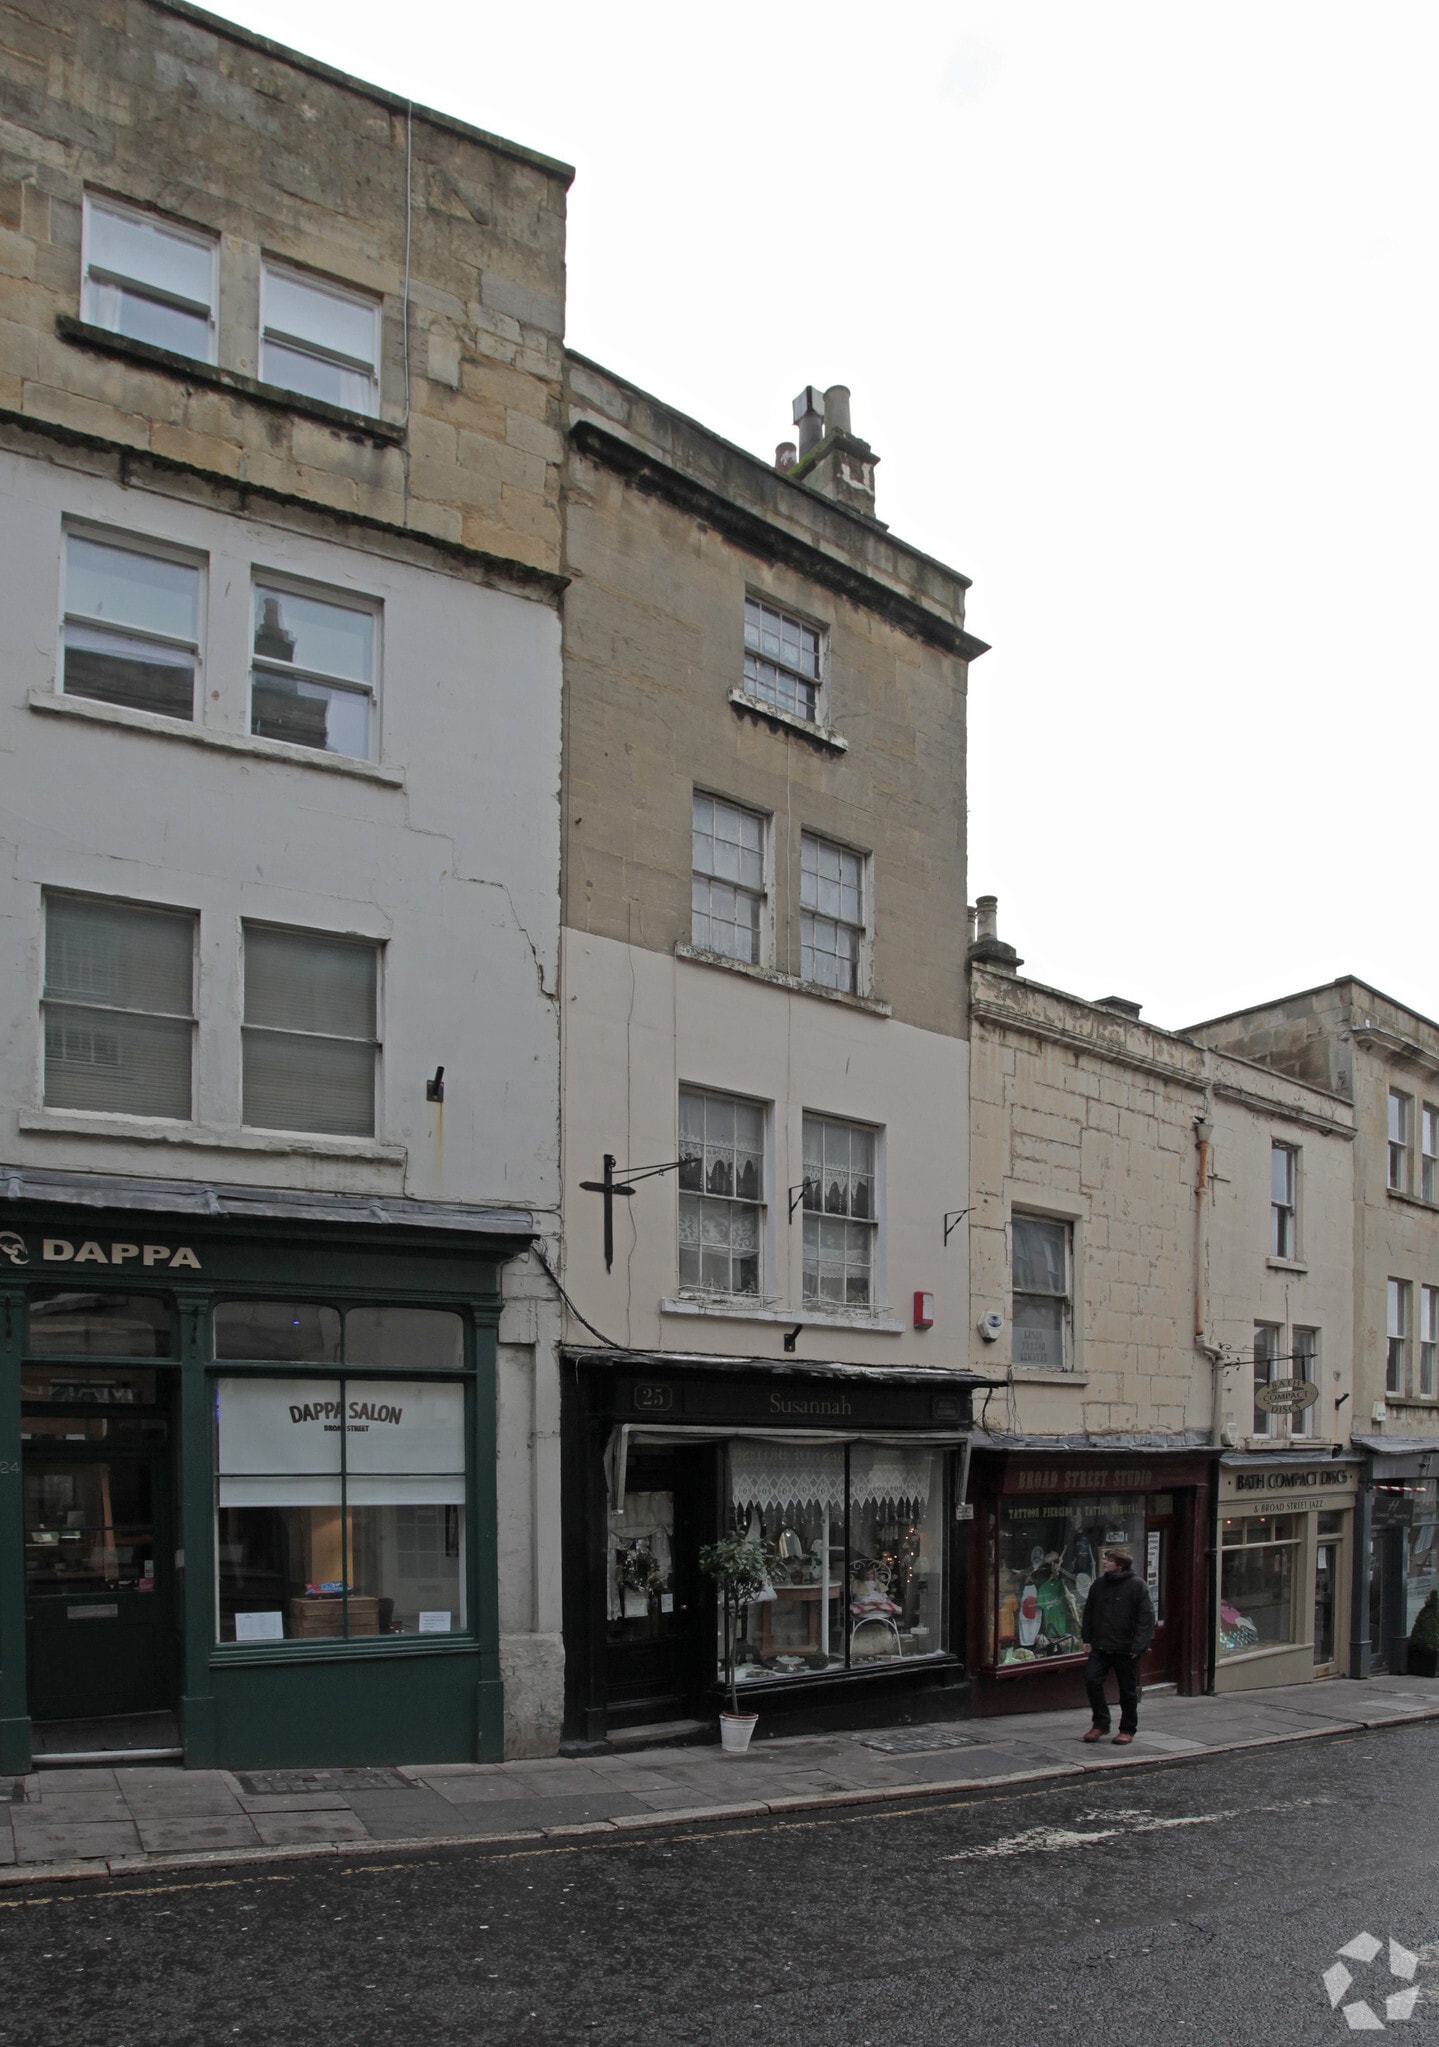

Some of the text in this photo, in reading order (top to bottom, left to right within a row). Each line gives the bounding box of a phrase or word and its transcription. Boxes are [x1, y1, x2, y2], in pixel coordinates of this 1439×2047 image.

[43, 1238, 202, 1269] DAPPA
[1271, 1380, 1302, 1389] BATH
[642, 1387, 664, 1406] 25
[769, 1393, 852, 1415] Susannah
[1263, 1390, 1309, 1402] COMPACT
[348, 1402, 402, 1424] SALON
[1271, 1404, 1301, 1414] DISCS
[0, 1461, 20, 1474] 24
[1019, 1470, 1152, 1489] BROAD STREET STUDIO
[1237, 1469, 1347, 1490] BATH COMPACT DISCS
[1008, 1508, 1040, 1519] TATTOOS
[1253, 1500, 1323, 1513] & BROAD STREET JAZZ
